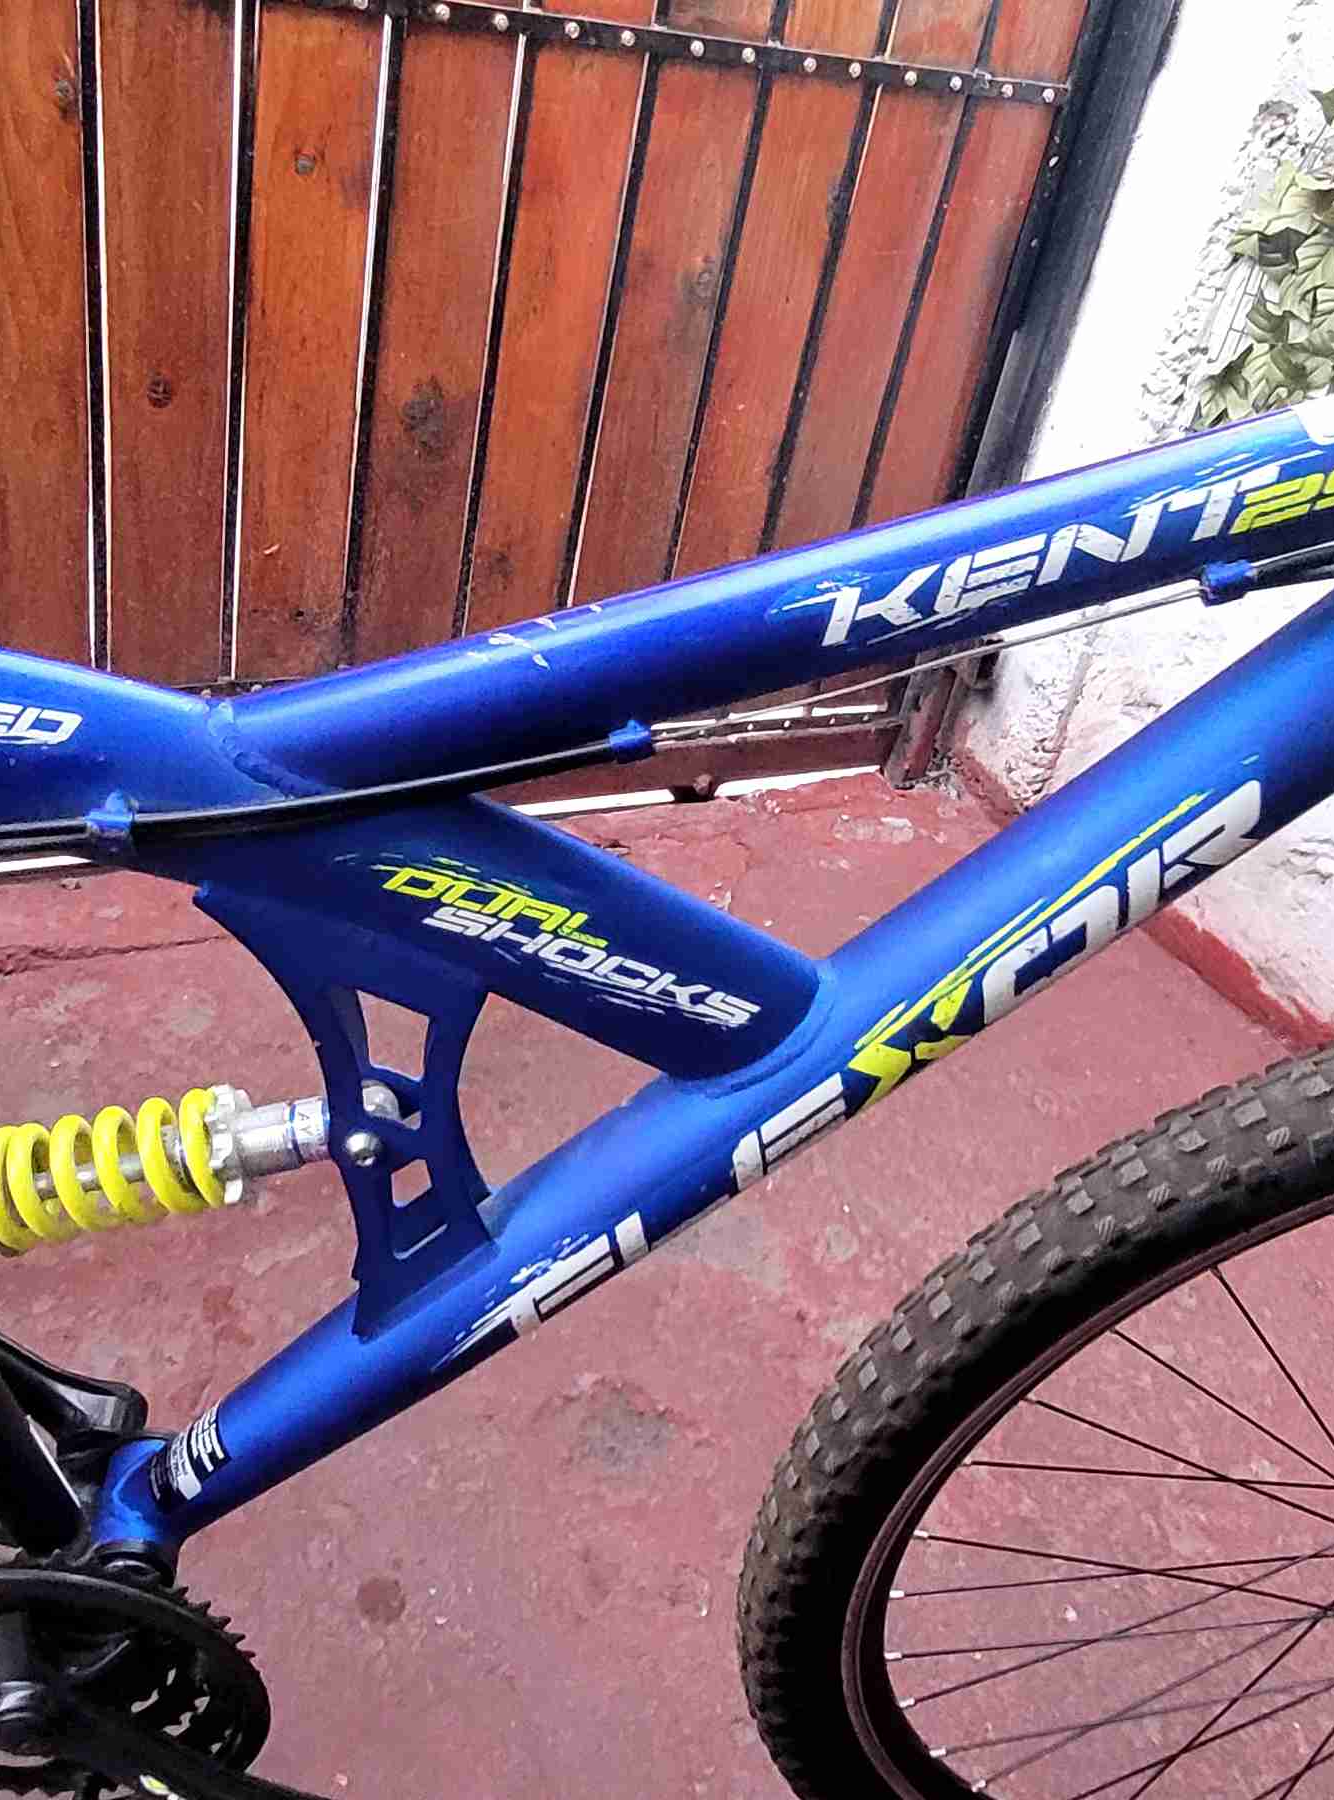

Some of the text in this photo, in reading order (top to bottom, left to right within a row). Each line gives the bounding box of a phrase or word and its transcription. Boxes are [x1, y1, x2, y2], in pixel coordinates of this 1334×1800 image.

[792, 464, 1281, 647] KENT
[379, 866, 609, 949] DUAL
[422, 906, 761, 1028] SHOCKS
